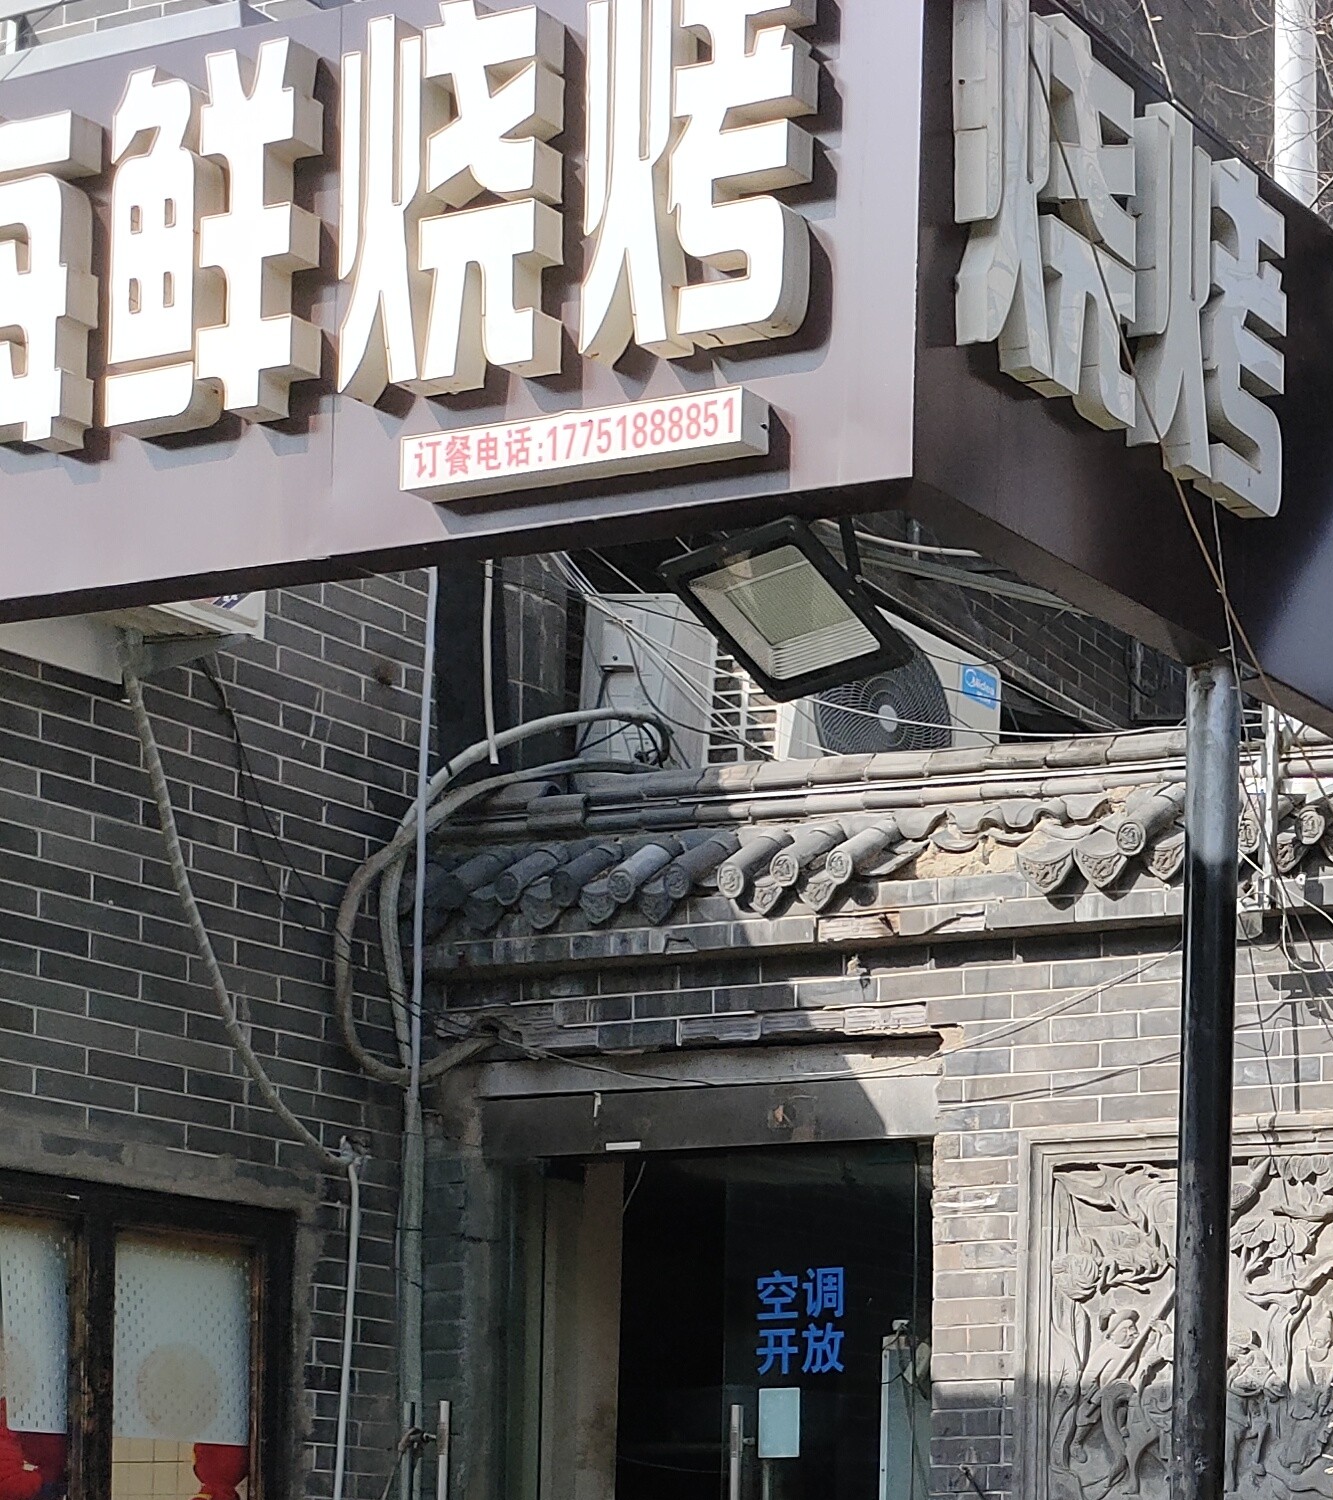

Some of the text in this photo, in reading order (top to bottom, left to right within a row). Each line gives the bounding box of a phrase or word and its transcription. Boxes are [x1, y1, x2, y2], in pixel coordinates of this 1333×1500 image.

[954, 0, 1288, 518] 烧烤
[414, 398, 736, 479] 订餐电话:17751888851
[756, 1267, 844, 1320] 空调
[756, 1322, 844, 1375] 开放
